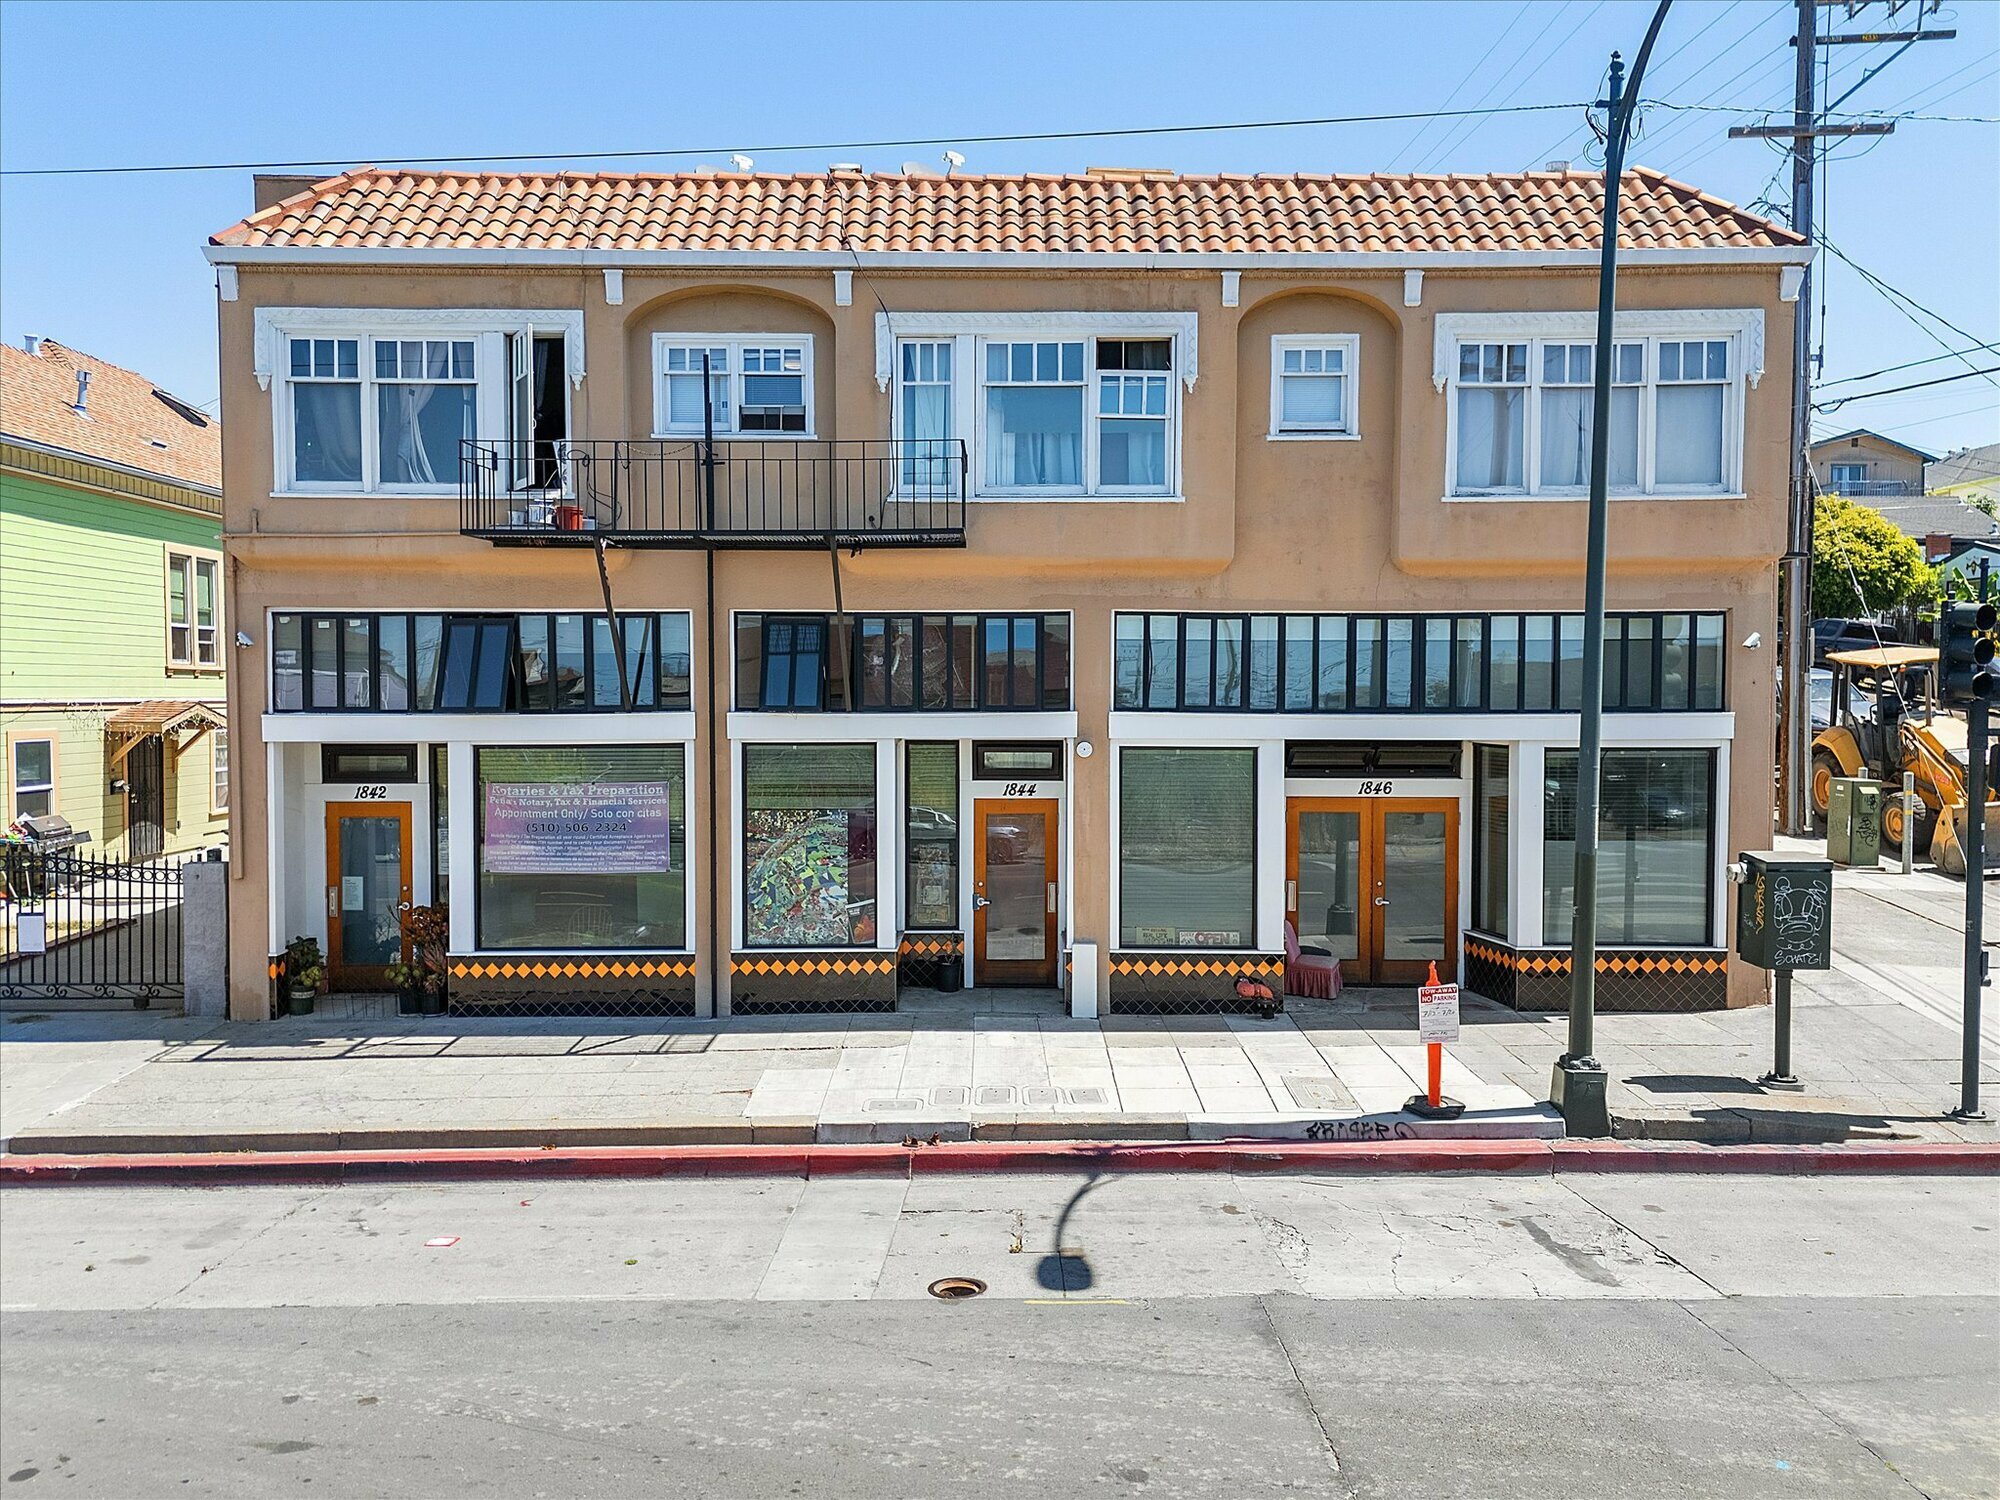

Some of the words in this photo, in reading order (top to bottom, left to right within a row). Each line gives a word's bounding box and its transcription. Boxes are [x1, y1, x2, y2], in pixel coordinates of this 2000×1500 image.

[354, 785, 387, 799] 1842
[561, 785, 584, 796] Tax
[588, 785, 664, 797] Preparation
[1003, 783, 1037, 796] 1844
[1358, 781, 1393, 795] 1846
[554, 798, 571, 806] Tax
[582, 798, 626, 806] Financial
[627, 797, 667, 805] Services
[494, 807, 558, 819] Appointment
[591, 808, 613, 818] Solo
[616, 810, 635, 818] con
[637, 808, 662, 818] citas
[526, 823, 560, 833] (510)
[565, 823, 589, 832] 506
[595, 823, 627, 832] 2324
[1194, 931, 1231, 945] OPEN
[1421, 987, 1457, 995] TOW-AWAY
[1421, 995, 1432, 1003] NO
